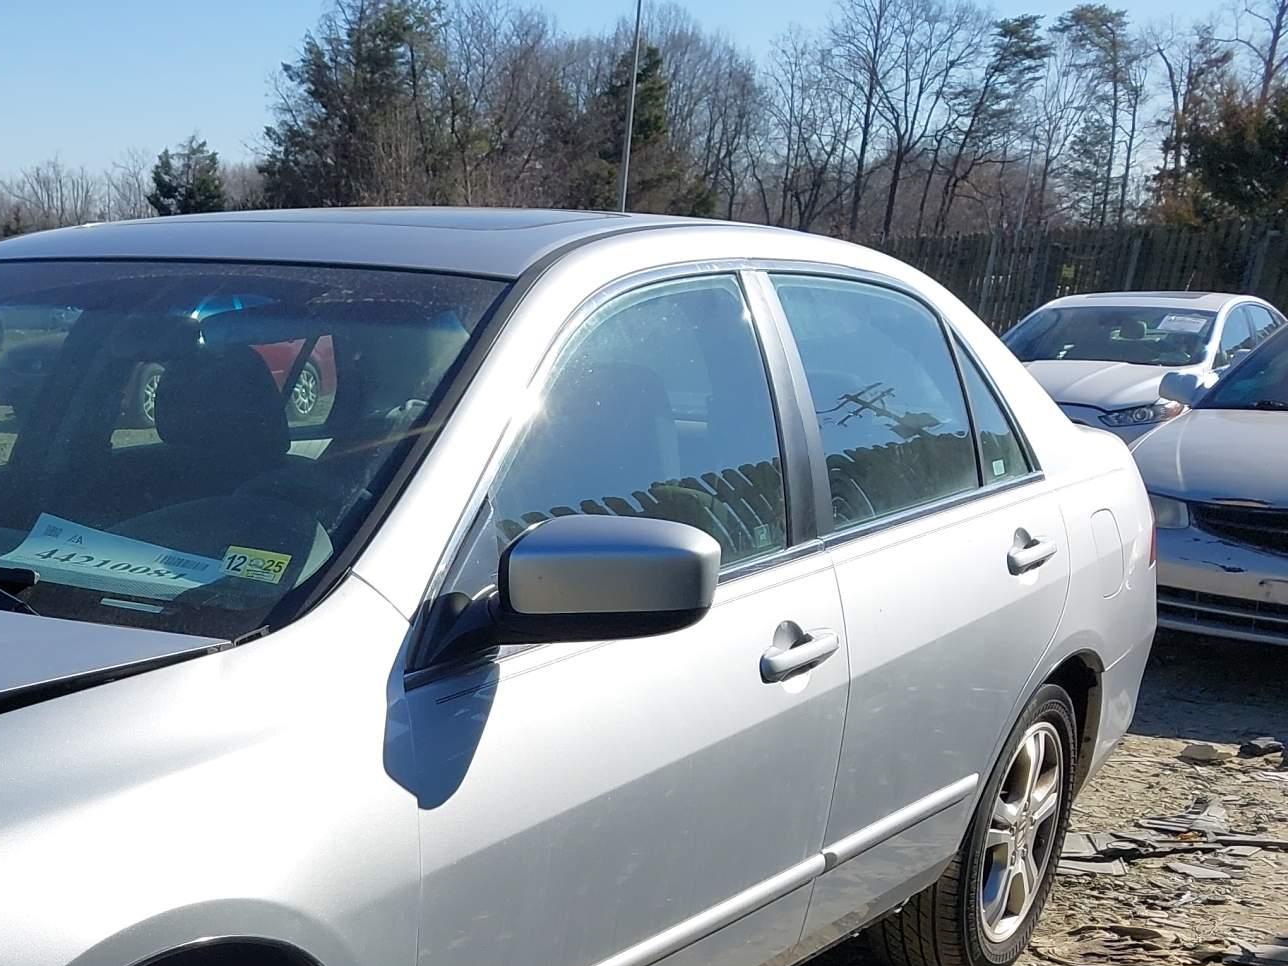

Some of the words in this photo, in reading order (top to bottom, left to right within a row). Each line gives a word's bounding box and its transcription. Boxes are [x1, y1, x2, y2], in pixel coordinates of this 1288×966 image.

[34, 548, 188, 581] 44210081
[225, 553, 248, 572] 12
[263, 559, 286, 574] 25
